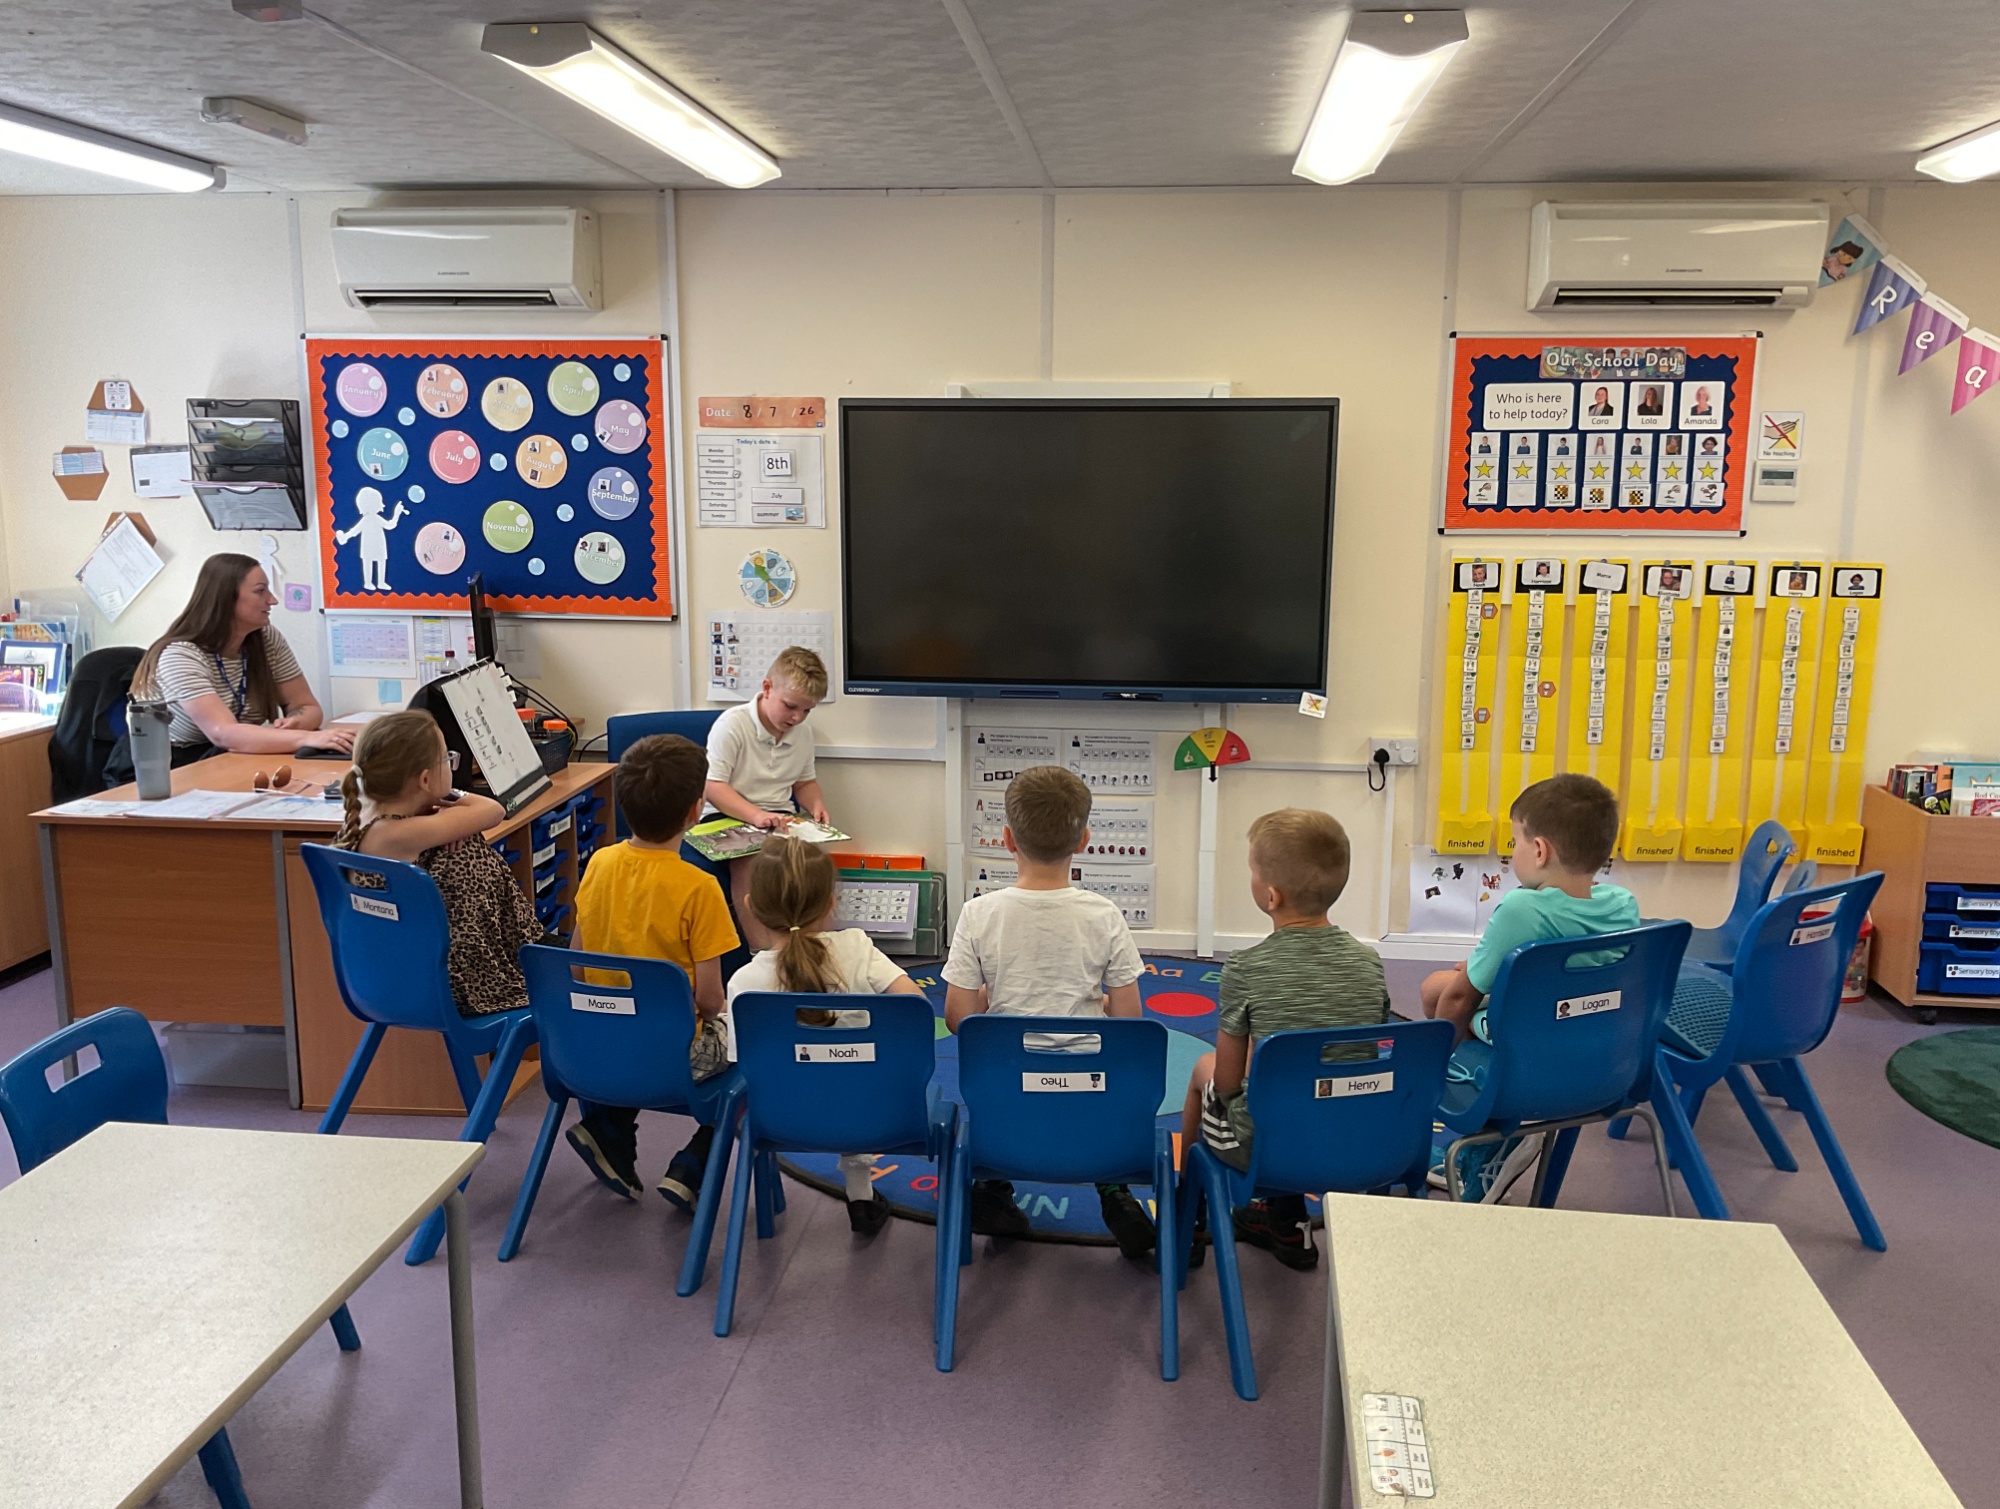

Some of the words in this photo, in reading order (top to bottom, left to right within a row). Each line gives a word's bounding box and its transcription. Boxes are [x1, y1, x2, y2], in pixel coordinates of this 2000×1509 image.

[1546, 352, 1576, 367] Our
[1583, 352, 1640, 367] School
[1645, 352, 1678, 372] Day
[344, 386, 379, 399] January
[423, 385, 462, 400] February
[563, 384, 584, 397] April
[1496, 393, 1522, 404] Who
[1525, 393, 1534, 403] is
[1537, 393, 1562, 403] here
[742, 404, 753, 418] 8
[769, 406, 777, 417] 7
[799, 406, 815, 416] 26
[1489, 410, 1500, 420] to
[1503, 409, 1528, 421] help
[1530, 408, 1568, 421] today?
[1591, 417, 1609, 425] Cara
[1641, 417, 1657, 425] Lola
[1684, 417, 1717, 425] Amanda
[611, 425, 630, 436] May
[371, 448, 391, 460] June
[445, 451, 464, 465] July
[526, 456, 556, 472] August
[766, 456, 788, 470] 8th
[592, 488, 637, 504] September
[486, 521, 530, 534] November
[425, 541, 458, 557] October
[579, 550, 621, 568] December
[1447, 840, 1485, 849] finished
[1636, 846, 1674, 855] finished
[1694, 846, 1734, 856] finished
[1816, 847, 1856, 857] finished
[363, 901, 395, 917] Montana
[1962, 928, 1988, 936] Sensory
[1959, 967, 1985, 975] Sensory
[587, 998, 616, 1010] Marco
[1582, 998, 1610, 1011] Logan
[828, 1047, 859, 1059] Noah
[1040, 1077, 1070, 1088] Theo
[1348, 1080, 1380, 1092] Henry
